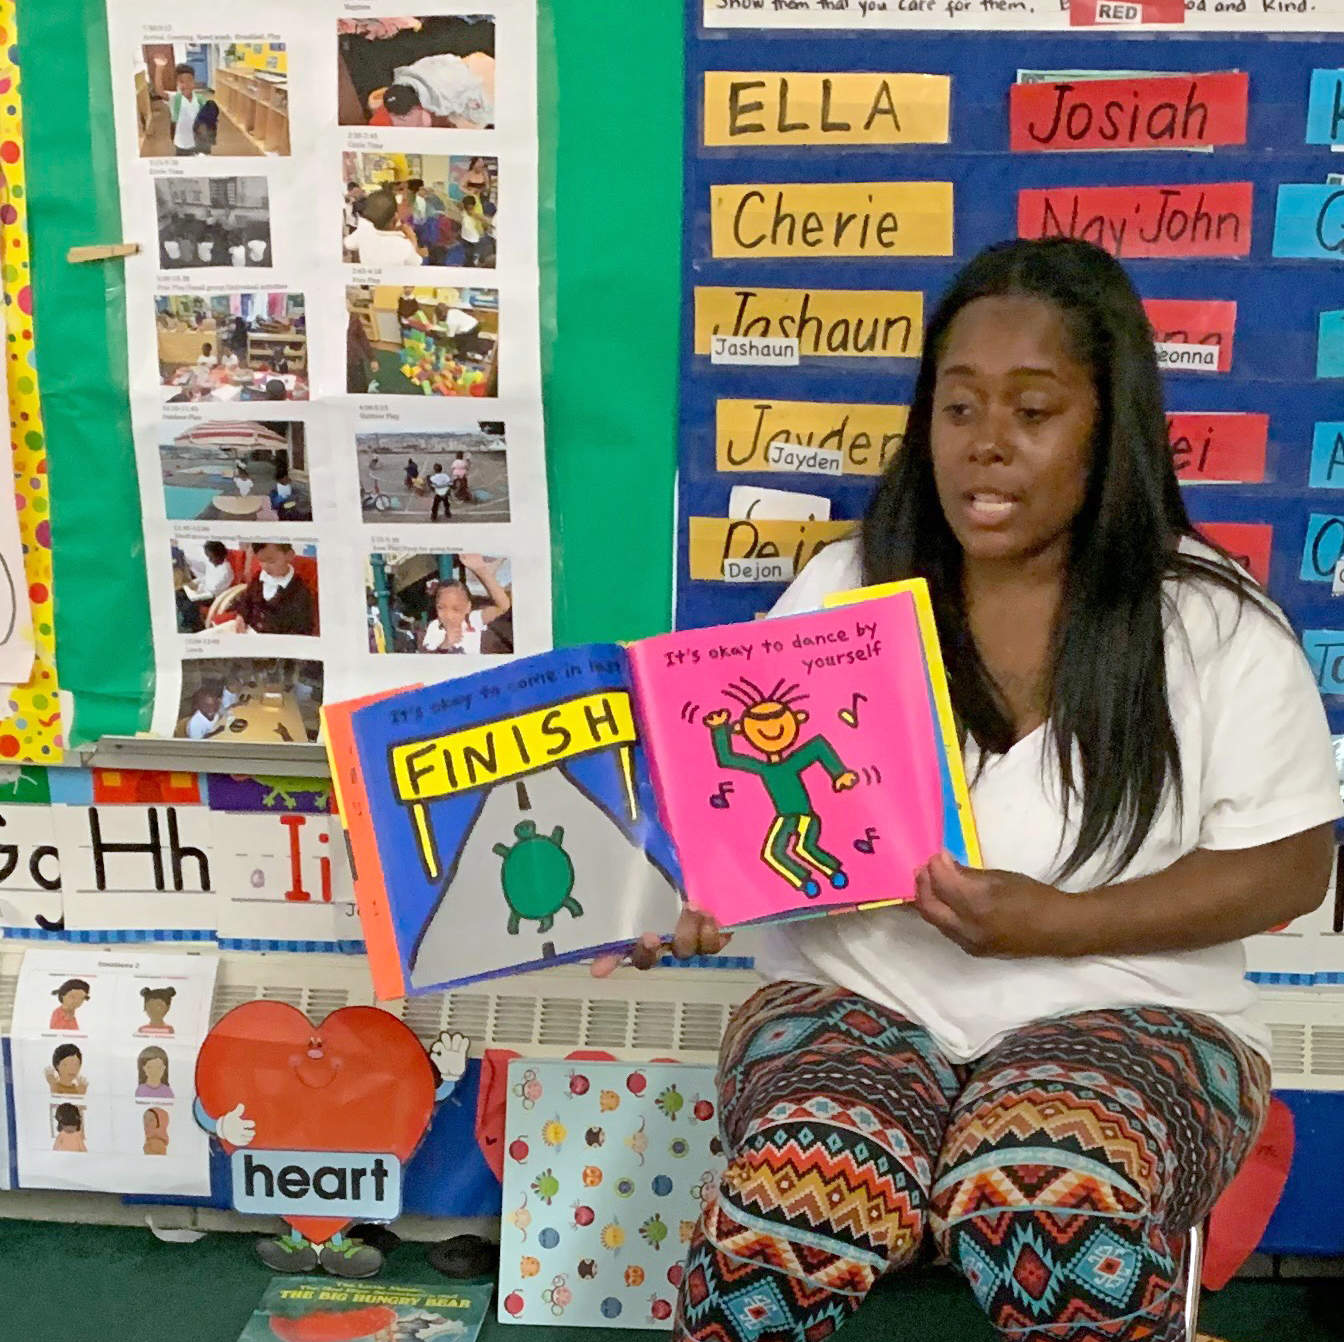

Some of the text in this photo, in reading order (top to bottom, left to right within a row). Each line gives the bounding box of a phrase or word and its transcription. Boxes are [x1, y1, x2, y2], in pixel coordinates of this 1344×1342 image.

[1098, 5, 1138, 20] RED
[729, 78, 901, 137] ELLA
[1028, 80, 1208, 144] Josiah
[734, 191, 899, 249] Cherie
[714, 338, 795, 360] Jashaun
[772, 446, 840, 471] Jayden
[729, 563, 782, 581] Dejon
[664, 622, 879, 669] It's okay to dance by
[803, 641, 882, 673] yourself
[406, 701, 620, 796] FINISH
[89, 805, 211, 893] Hh
[279, 814, 333, 902] Ii
[244, 1153, 389, 1203] heart
[319, 1291, 348, 1301] BIG
